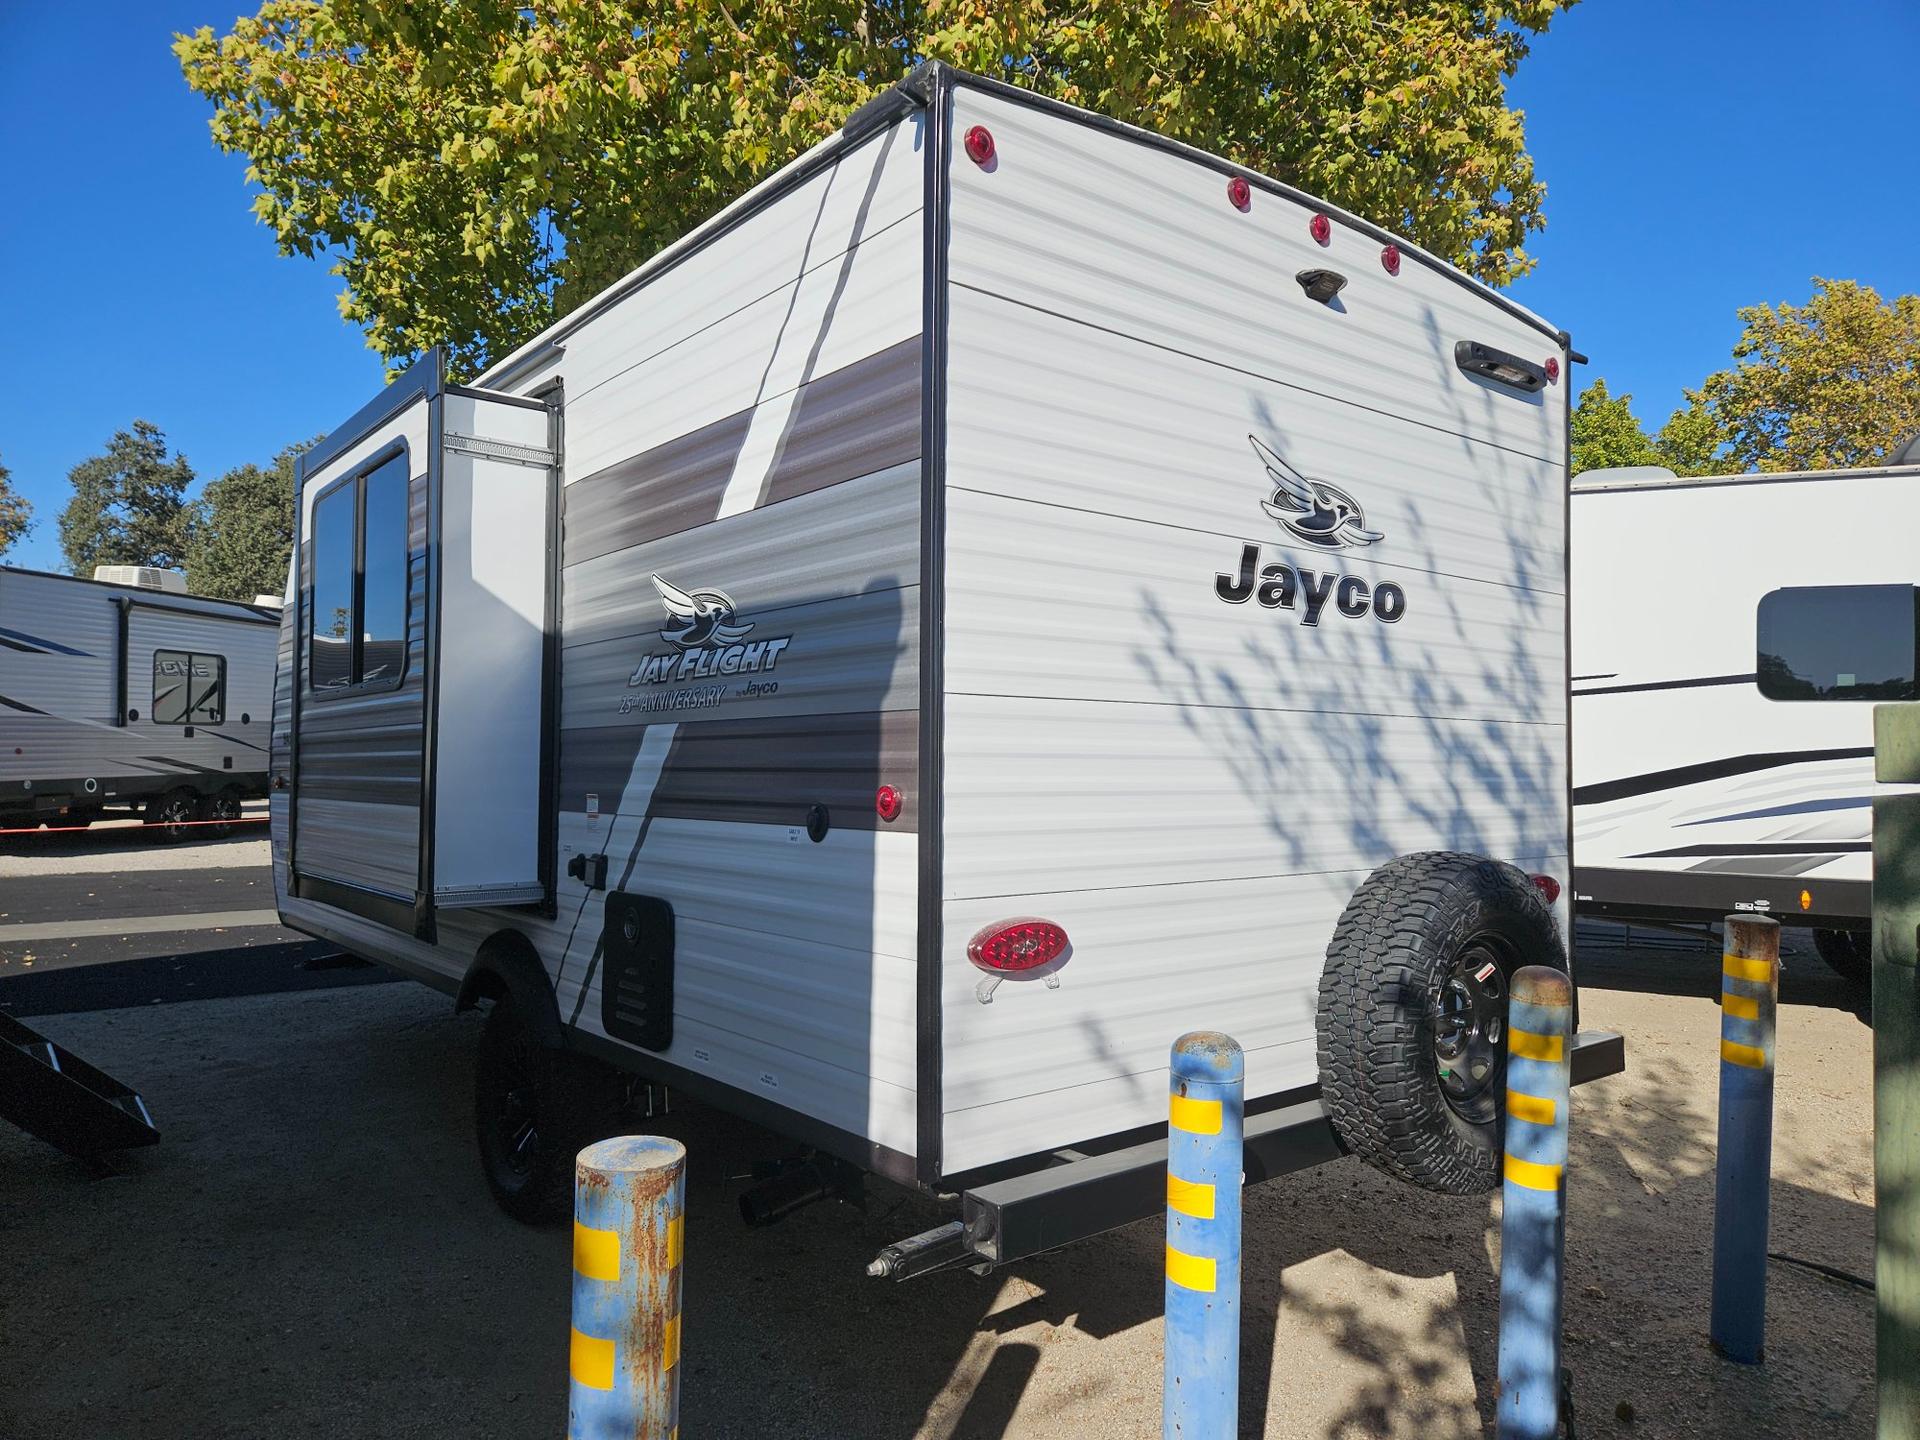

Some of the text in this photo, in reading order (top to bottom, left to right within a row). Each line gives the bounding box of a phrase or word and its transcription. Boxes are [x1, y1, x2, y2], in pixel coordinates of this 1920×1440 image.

[1214, 542, 1407, 627] Jayco
[629, 634, 792, 687] JAY FLIGHT
[640, 685, 727, 713] ANNIVERSARY
[742, 680, 778, 697] Jayco
